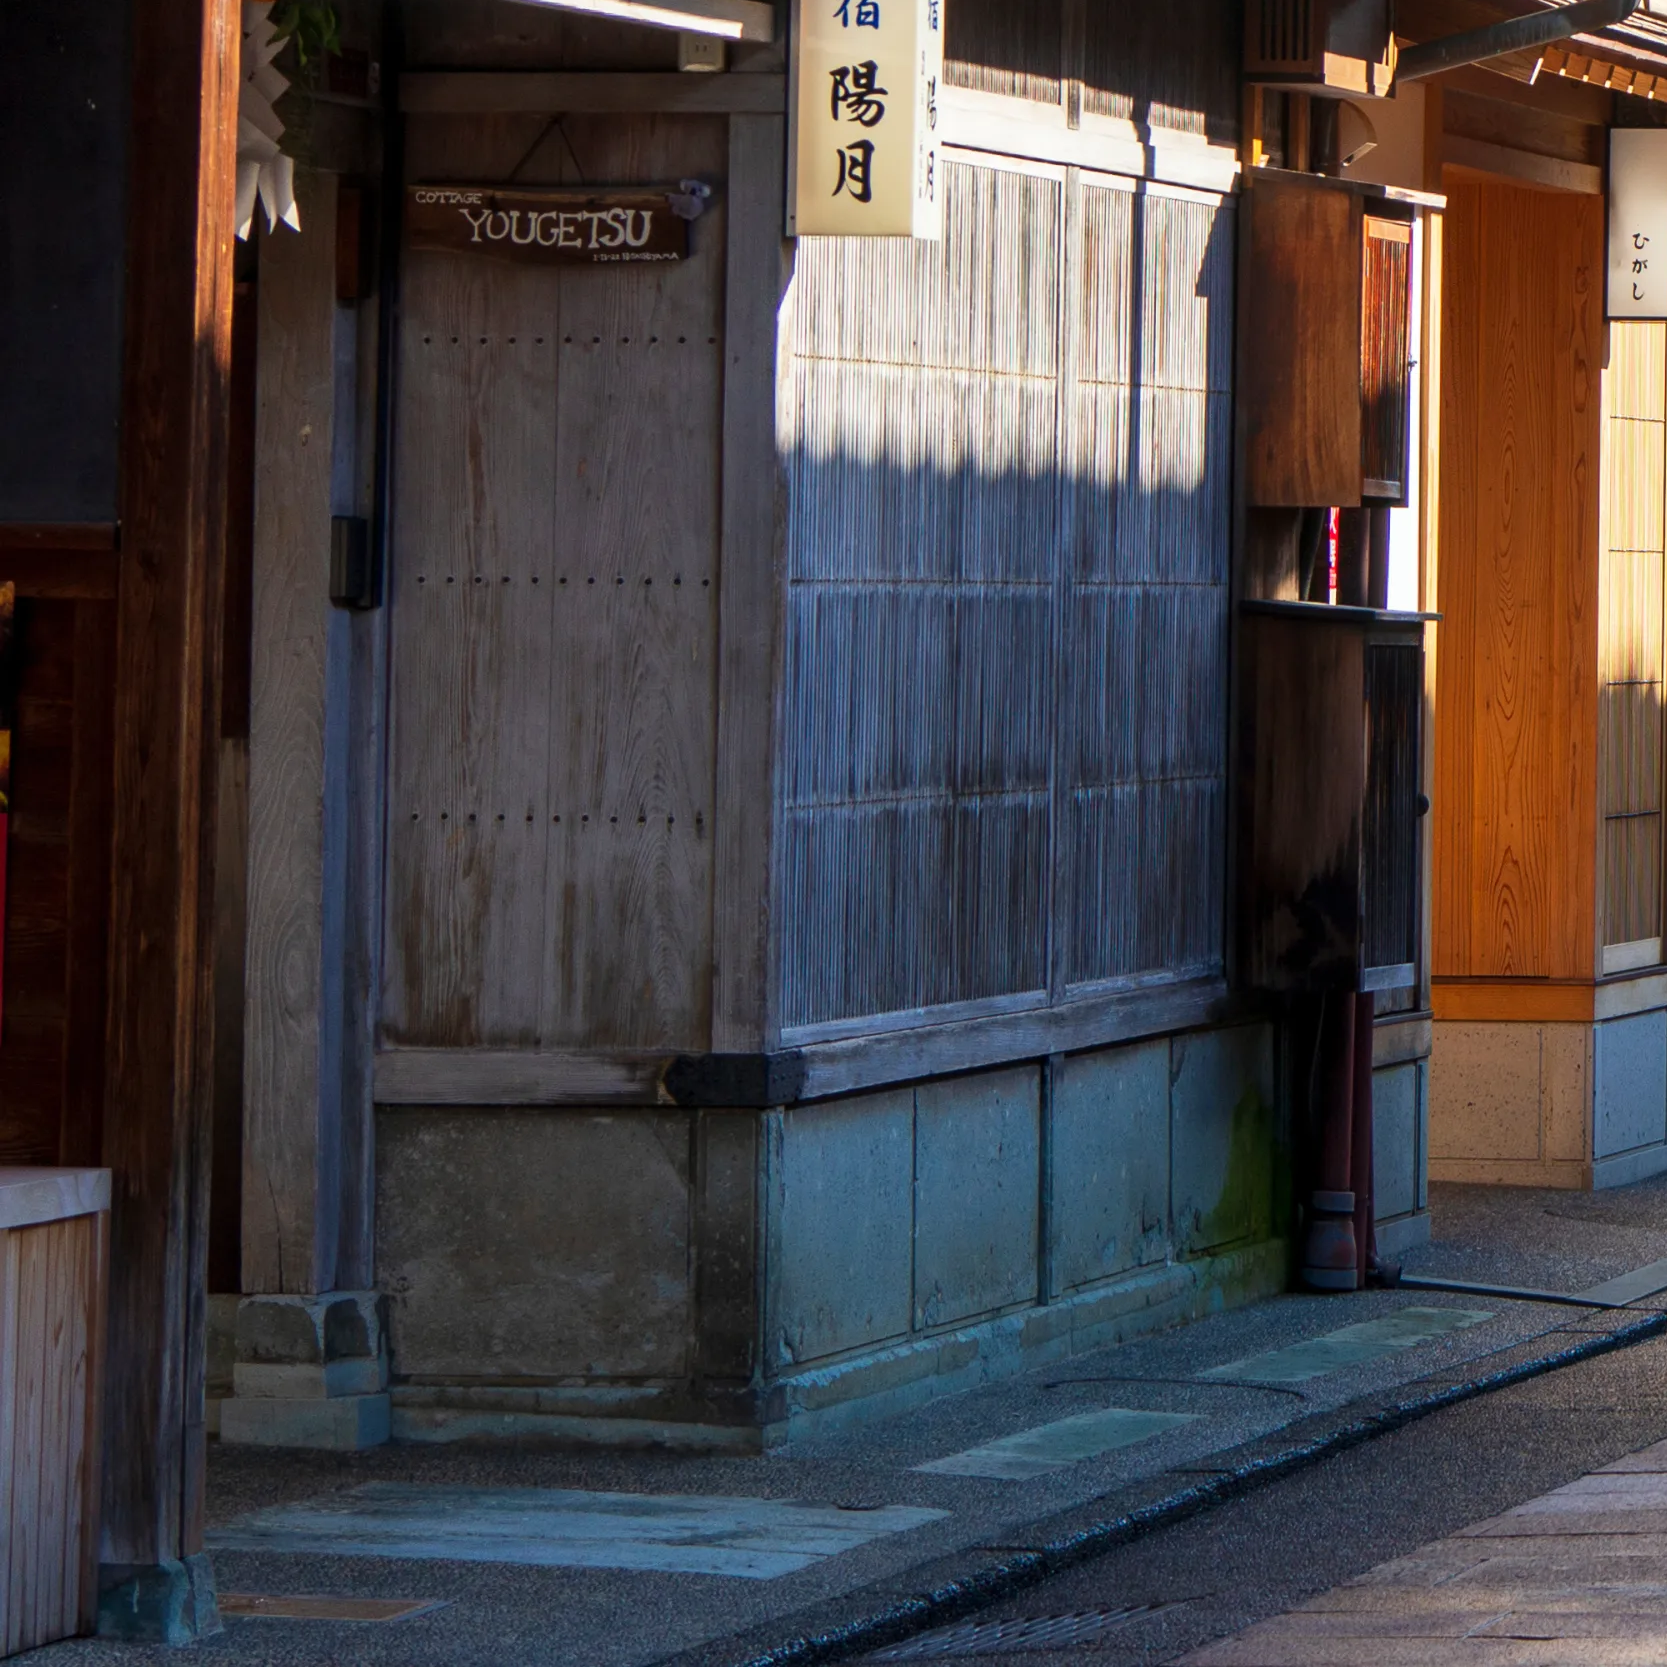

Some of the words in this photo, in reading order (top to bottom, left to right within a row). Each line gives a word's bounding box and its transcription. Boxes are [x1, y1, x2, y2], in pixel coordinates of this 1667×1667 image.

[415, 191, 483, 205] COTTAGE
[458, 207, 653, 248] YOUGETSU
[1632, 232, 1650, 301] ひがし
